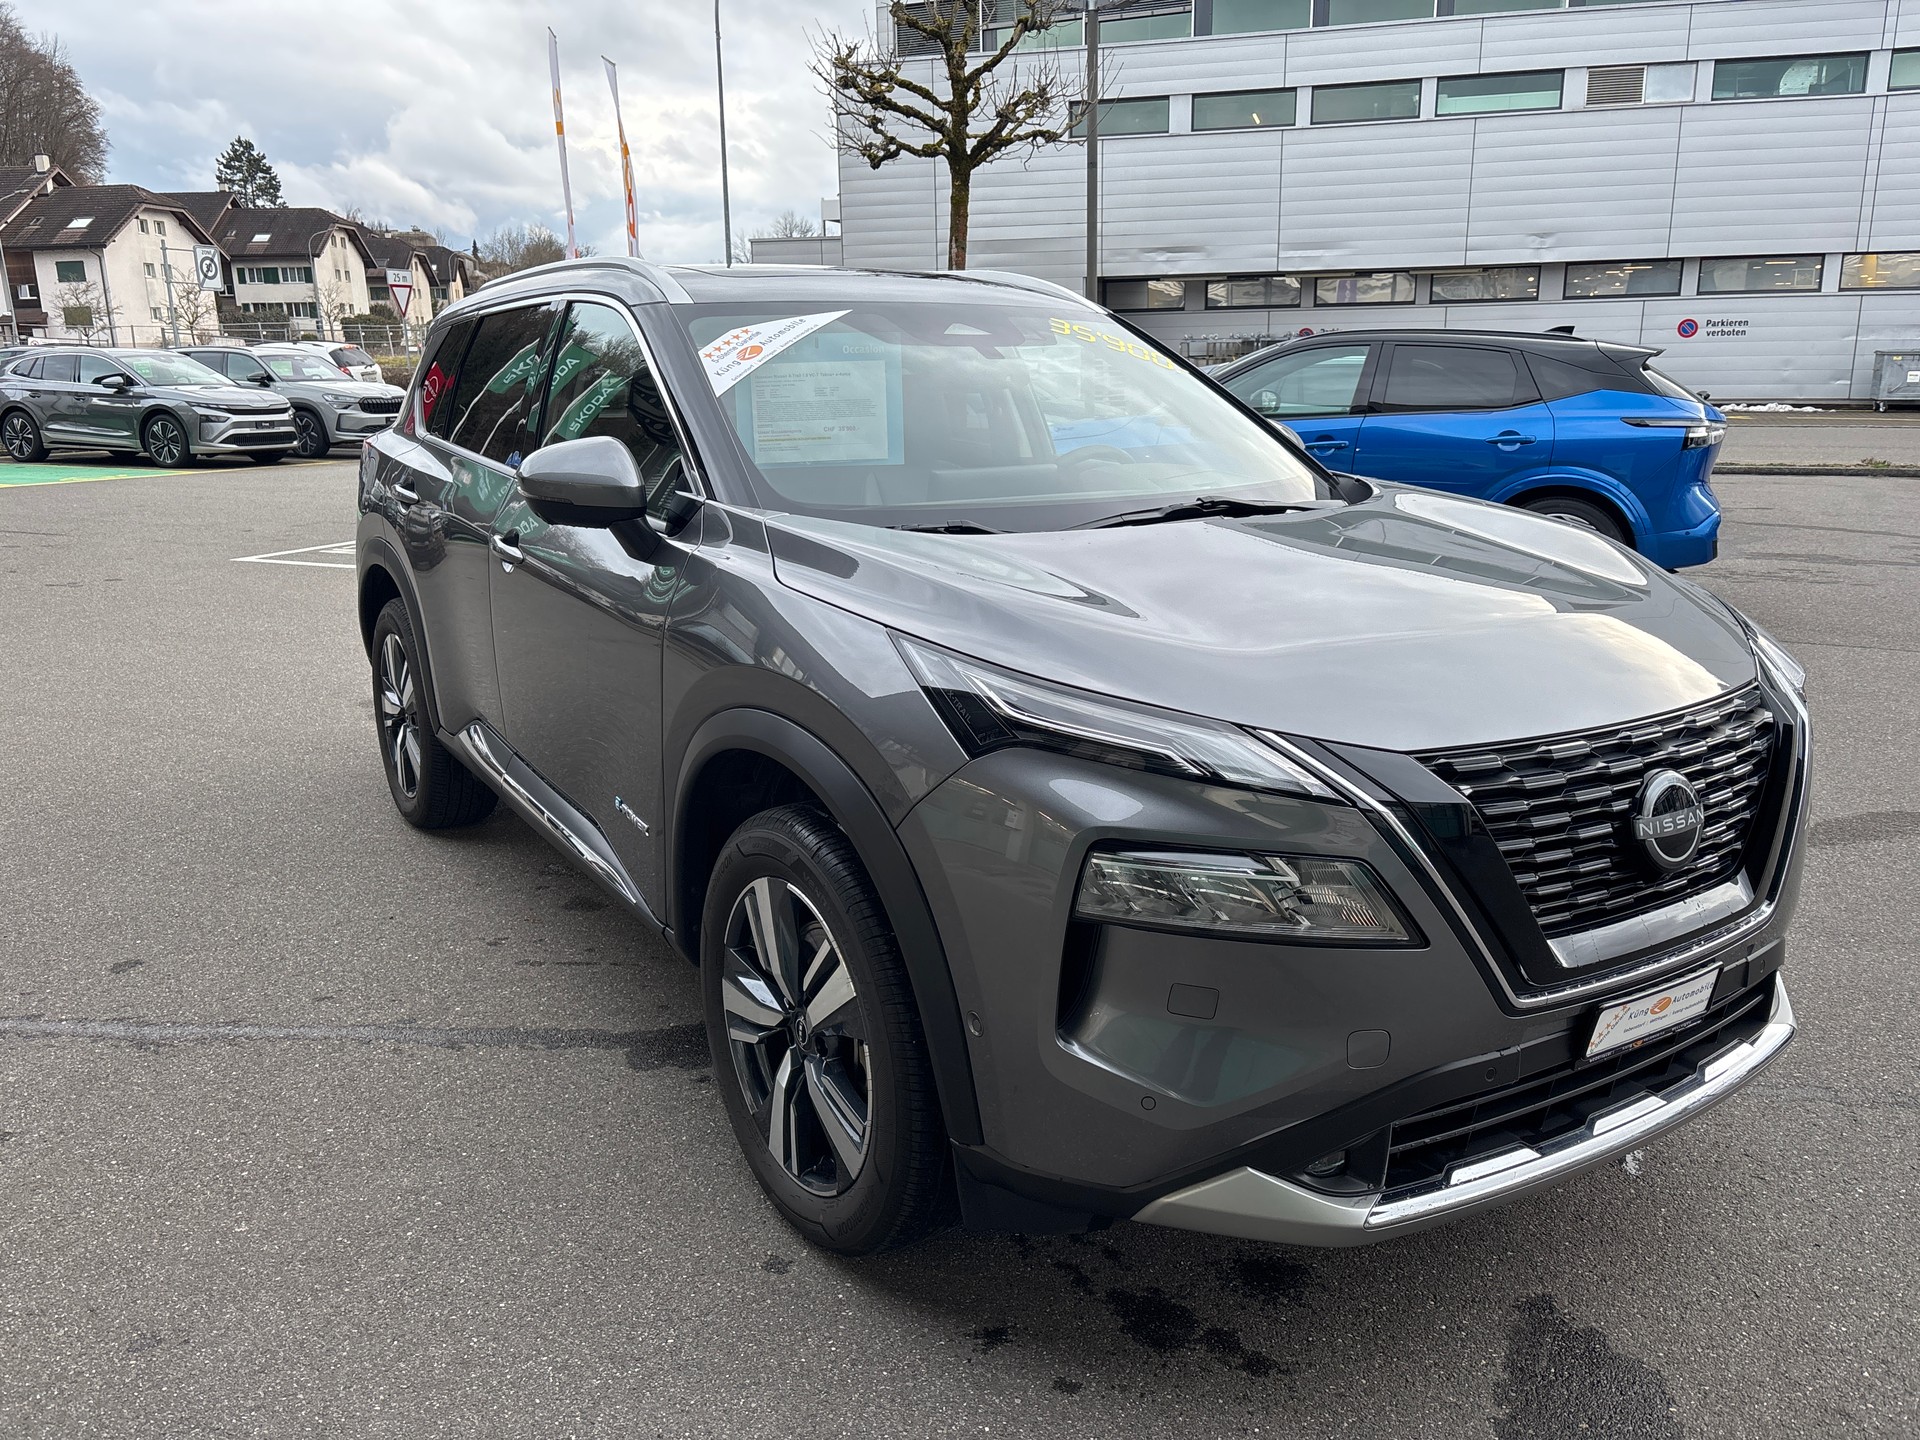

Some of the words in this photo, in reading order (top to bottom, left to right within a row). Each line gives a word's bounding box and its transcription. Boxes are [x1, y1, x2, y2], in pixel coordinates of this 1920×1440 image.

[205, 263, 214, 273] 30
[393, 273, 401, 282] 25
[1705, 319, 1749, 327] Parkieren
[1705, 328, 1747, 337] verboten
[714, 360, 742, 377] Küng
[759, 318, 807, 347] Automobile
[842, 344, 885, 354] Occasion
[1639, 809, 1704, 837] NISSAN
[1628, 1007, 1650, 1020] Küng
[1672, 982, 1714, 1005] Automobile
